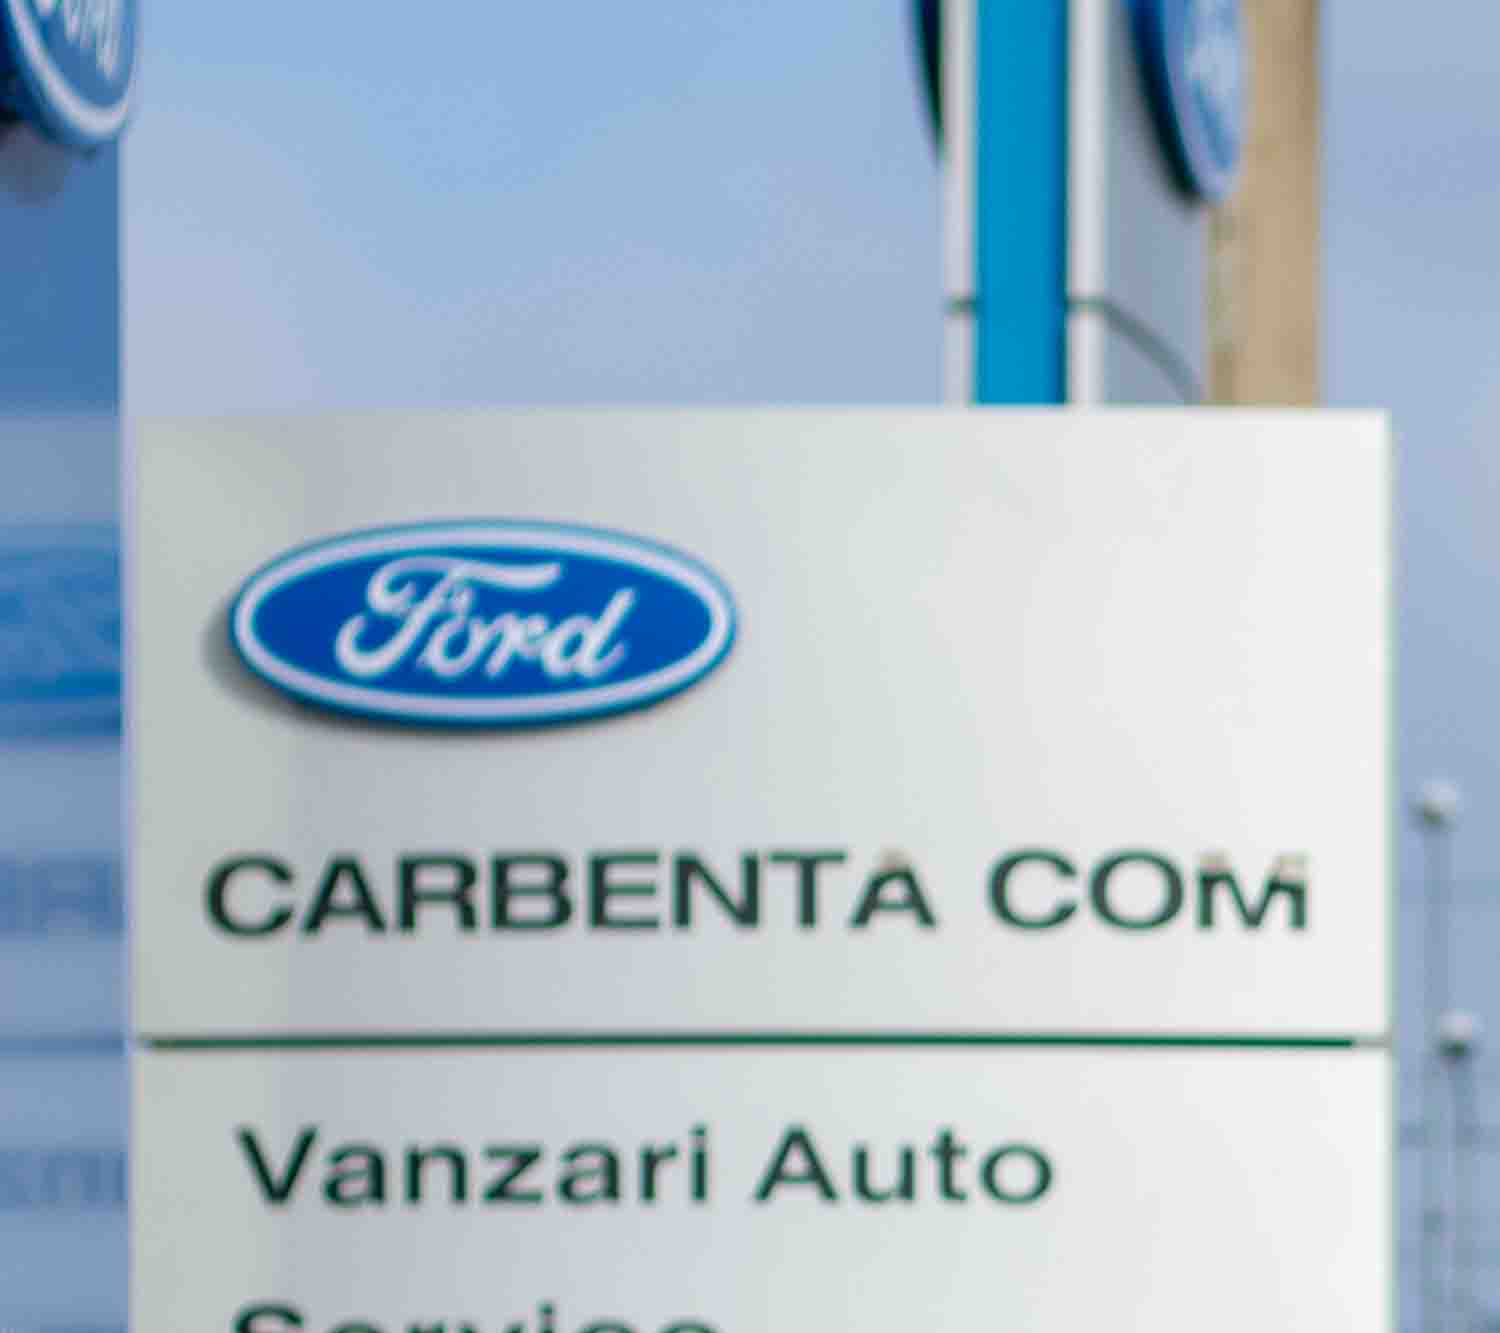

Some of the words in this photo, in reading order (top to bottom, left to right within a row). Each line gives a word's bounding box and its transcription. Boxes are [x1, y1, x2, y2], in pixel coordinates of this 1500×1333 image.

[335, 554, 637, 679] Ford
[203, 850, 938, 940] CARBENTA
[986, 848, 1308, 931] COM
[234, 1124, 711, 1208] Vanzari
[753, 1126, 1056, 1206] Auto
